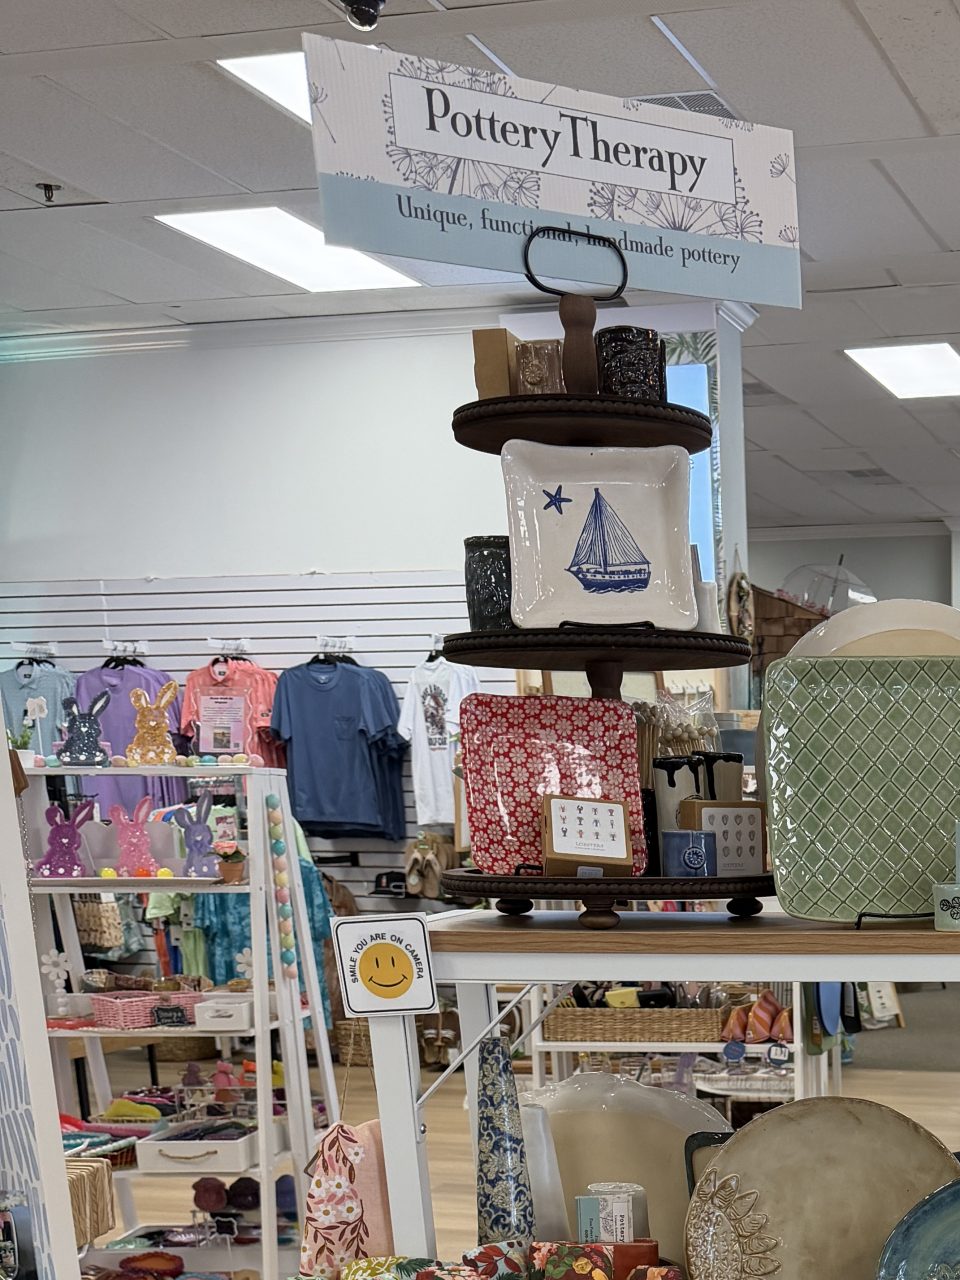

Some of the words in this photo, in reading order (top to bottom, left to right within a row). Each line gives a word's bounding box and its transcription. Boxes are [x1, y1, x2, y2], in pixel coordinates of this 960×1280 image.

[397, 193, 474, 230] Unique,
[584, 223, 674, 259] handmade
[680, 245, 742, 274] pottery
[352, 938, 368, 954] YOU
[369, 932, 387, 942] ARE
[390, 934, 404, 945] ON
[349, 956, 359, 984] SMILE
[404, 943, 424, 979] CAMERA
